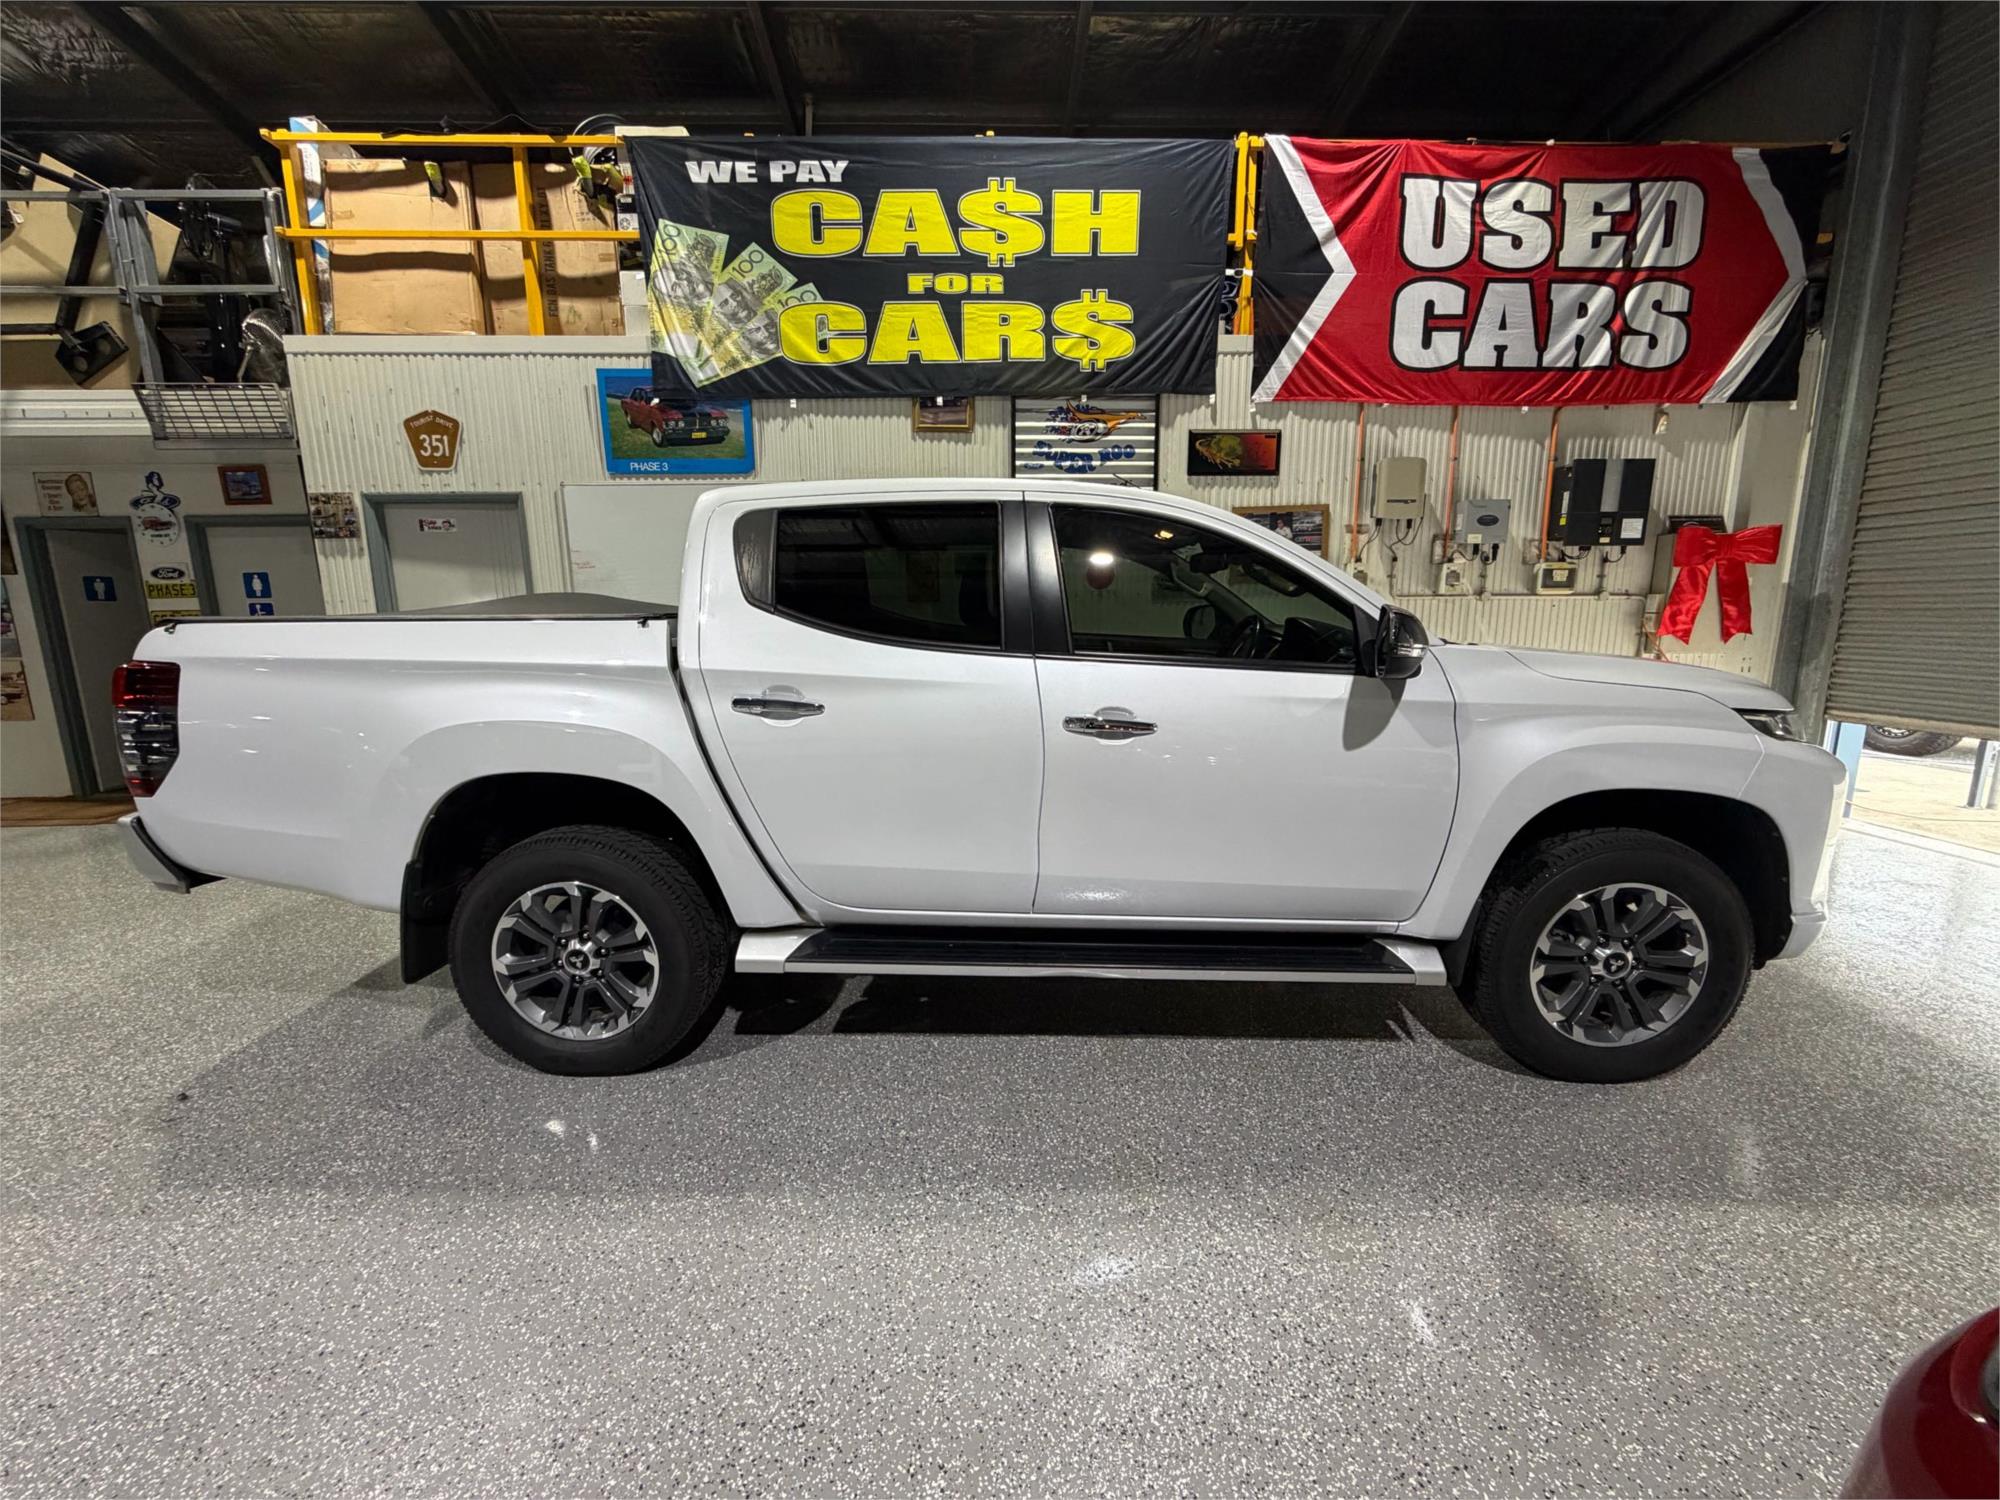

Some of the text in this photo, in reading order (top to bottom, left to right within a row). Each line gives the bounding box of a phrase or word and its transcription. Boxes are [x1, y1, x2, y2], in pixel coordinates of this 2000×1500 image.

[684, 160, 849, 183] WE PAY
[771, 177, 1141, 267] CA$H
[1401, 173, 1704, 271] USED
[732, 249, 765, 279] 100
[907, 273, 1004, 294] FOR
[779, 289, 1136, 372] CAR$
[1390, 277, 1692, 371] CARS
[419, 434, 449, 457] 351
[629, 462, 669, 471] PHASE 3
[148, 583, 185, 598] PHASE
